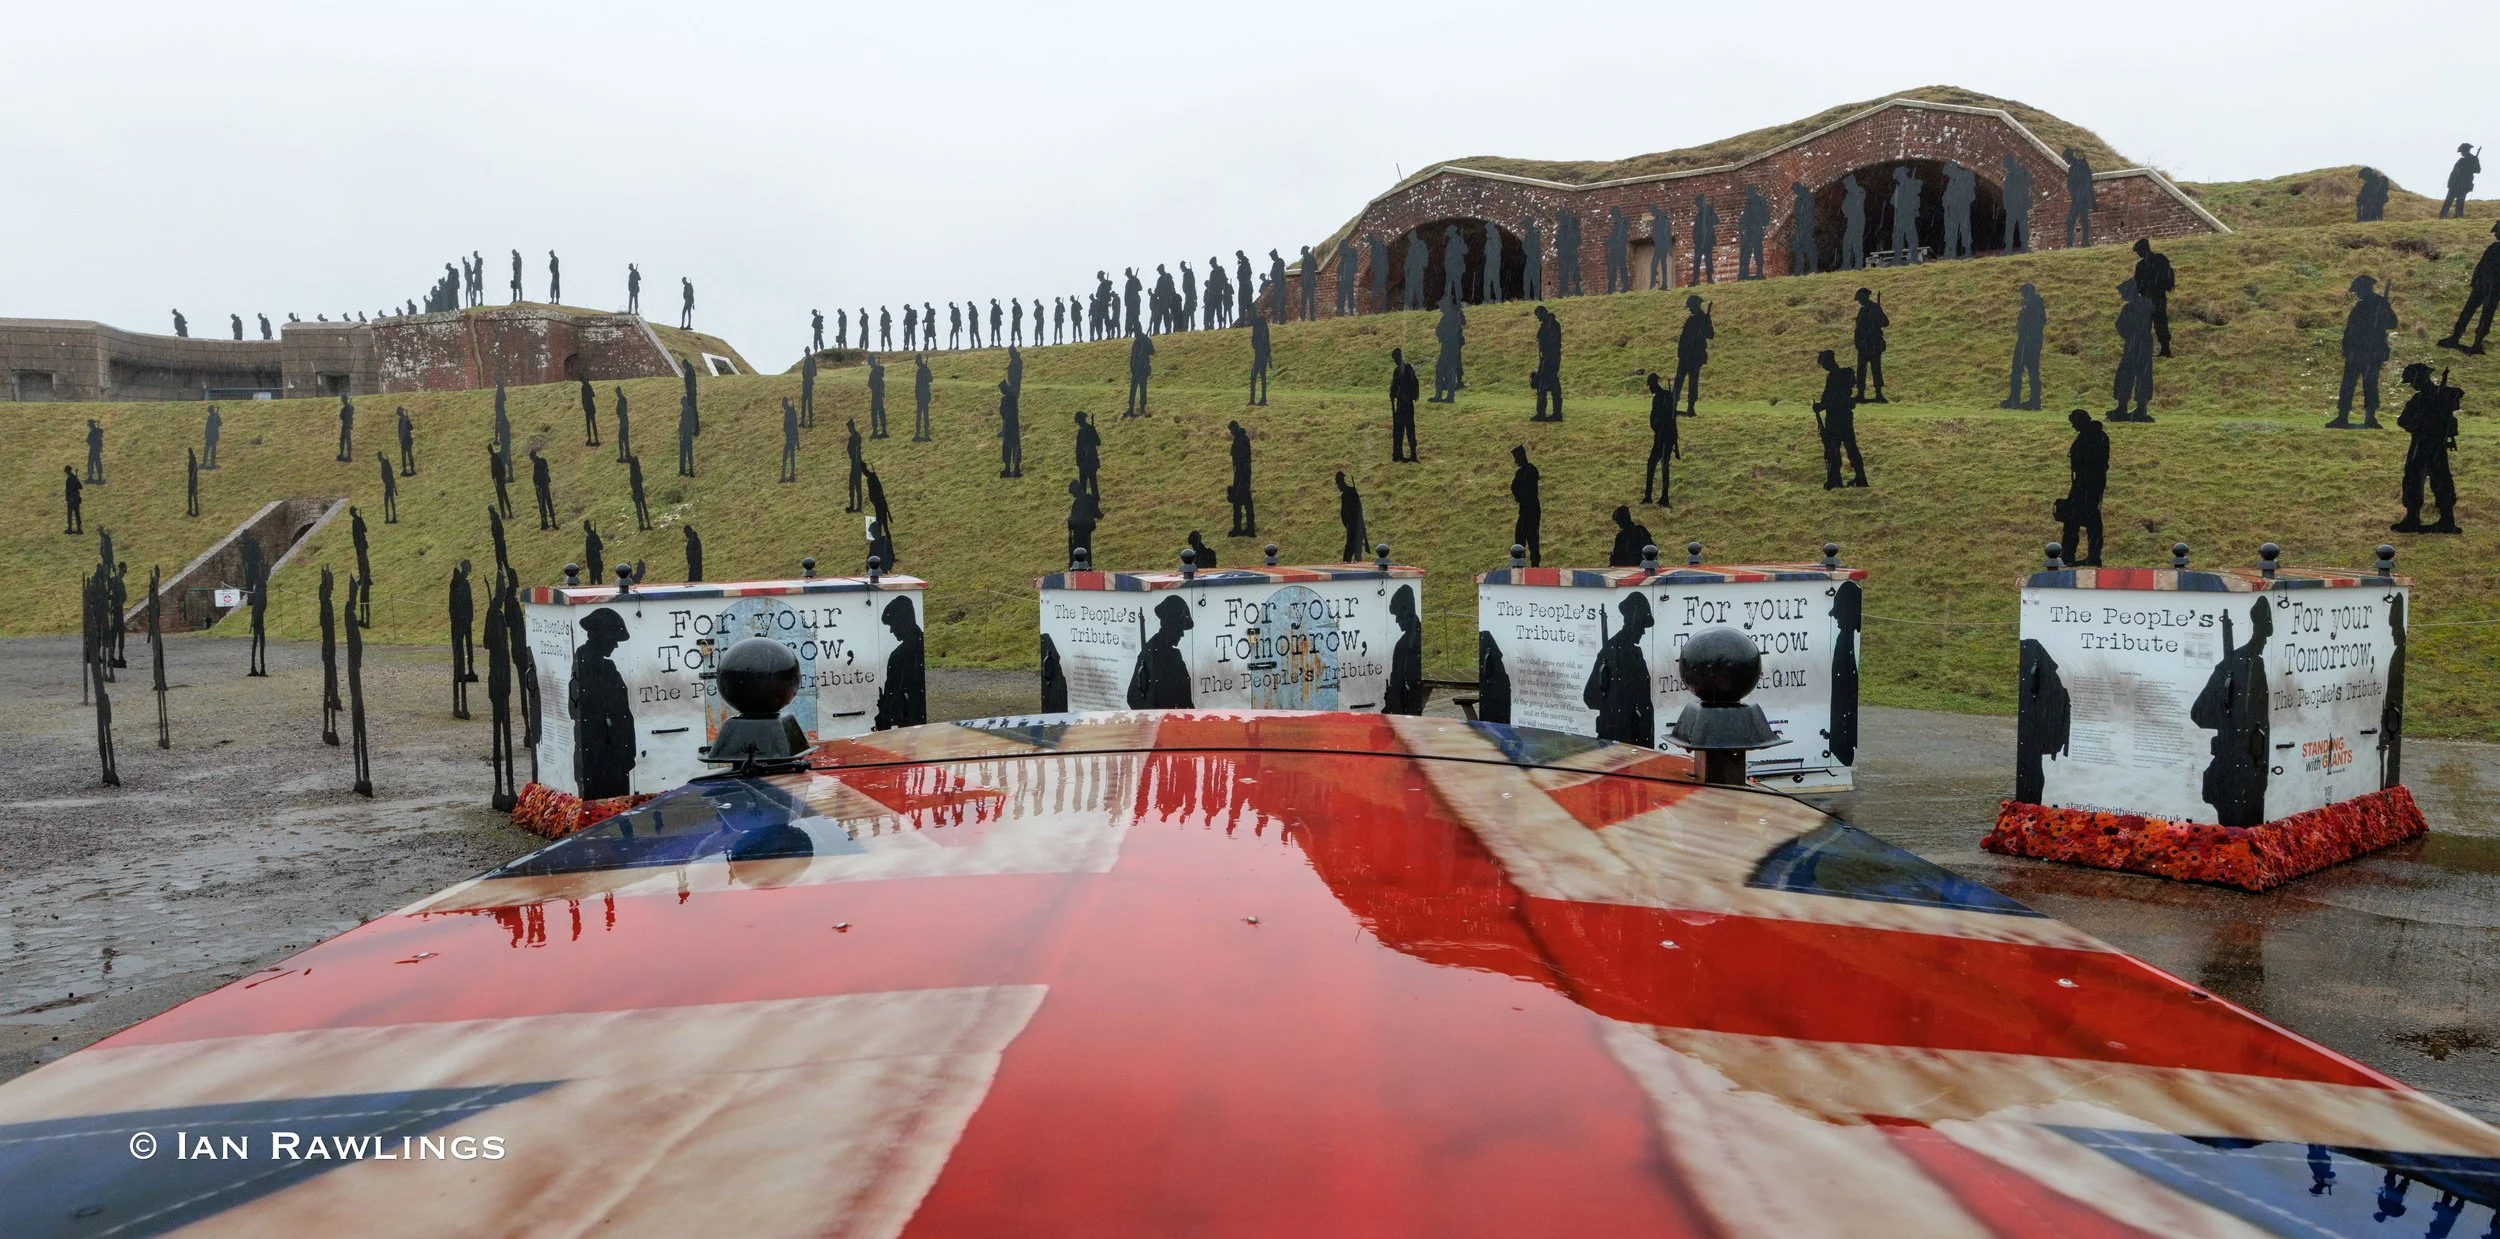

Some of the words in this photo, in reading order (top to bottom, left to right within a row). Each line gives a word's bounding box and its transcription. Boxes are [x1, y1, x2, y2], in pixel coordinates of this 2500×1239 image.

[669, 610, 736, 639] For
[753, 607, 842, 638] your
[1054, 604, 1076, 620] The
[1081, 606, 1137, 626] People's
[1225, 598, 1276, 628] For
[1291, 597, 1359, 630] your
[1497, 601, 1523, 617] The
[1529, 602, 1597, 623] People's
[1682, 596, 1731, 626] For
[1744, 597, 1808, 630] your
[2050, 606, 2092, 623] The
[2103, 608, 2214, 630] People's
[2291, 602, 2324, 635] For
[2330, 603, 2373, 640] your
[1071, 628, 1120, 645] Tribute
[1215, 630, 1368, 663] Tomorrow,
[1515, 625, 1575, 643] Tribute
[1674, 632, 1809, 662] Trow
[2081, 632, 2178, 653] Tribute
[658, 639, 855, 673] Tomow,
[2284, 642, 2375, 676] Tomorrow,
[639, 685, 681, 703] The
[800, 670, 875, 689] Tribute
[1201, 675, 1233, 694] The
[1241, 667, 1315, 690] People's
[1322, 661, 1383, 682] Tribute
[2273, 690, 2293, 711] The
[2297, 683, 2342, 708] People's
[2346, 679, 2383, 700] Tribute
[2302, 736, 2344, 758] STANDNG
[2306, 756, 2321, 772] with
[2322, 749, 2353, 768] GANTS
[2066, 801, 2182, 823] standingwithgiants.couk
